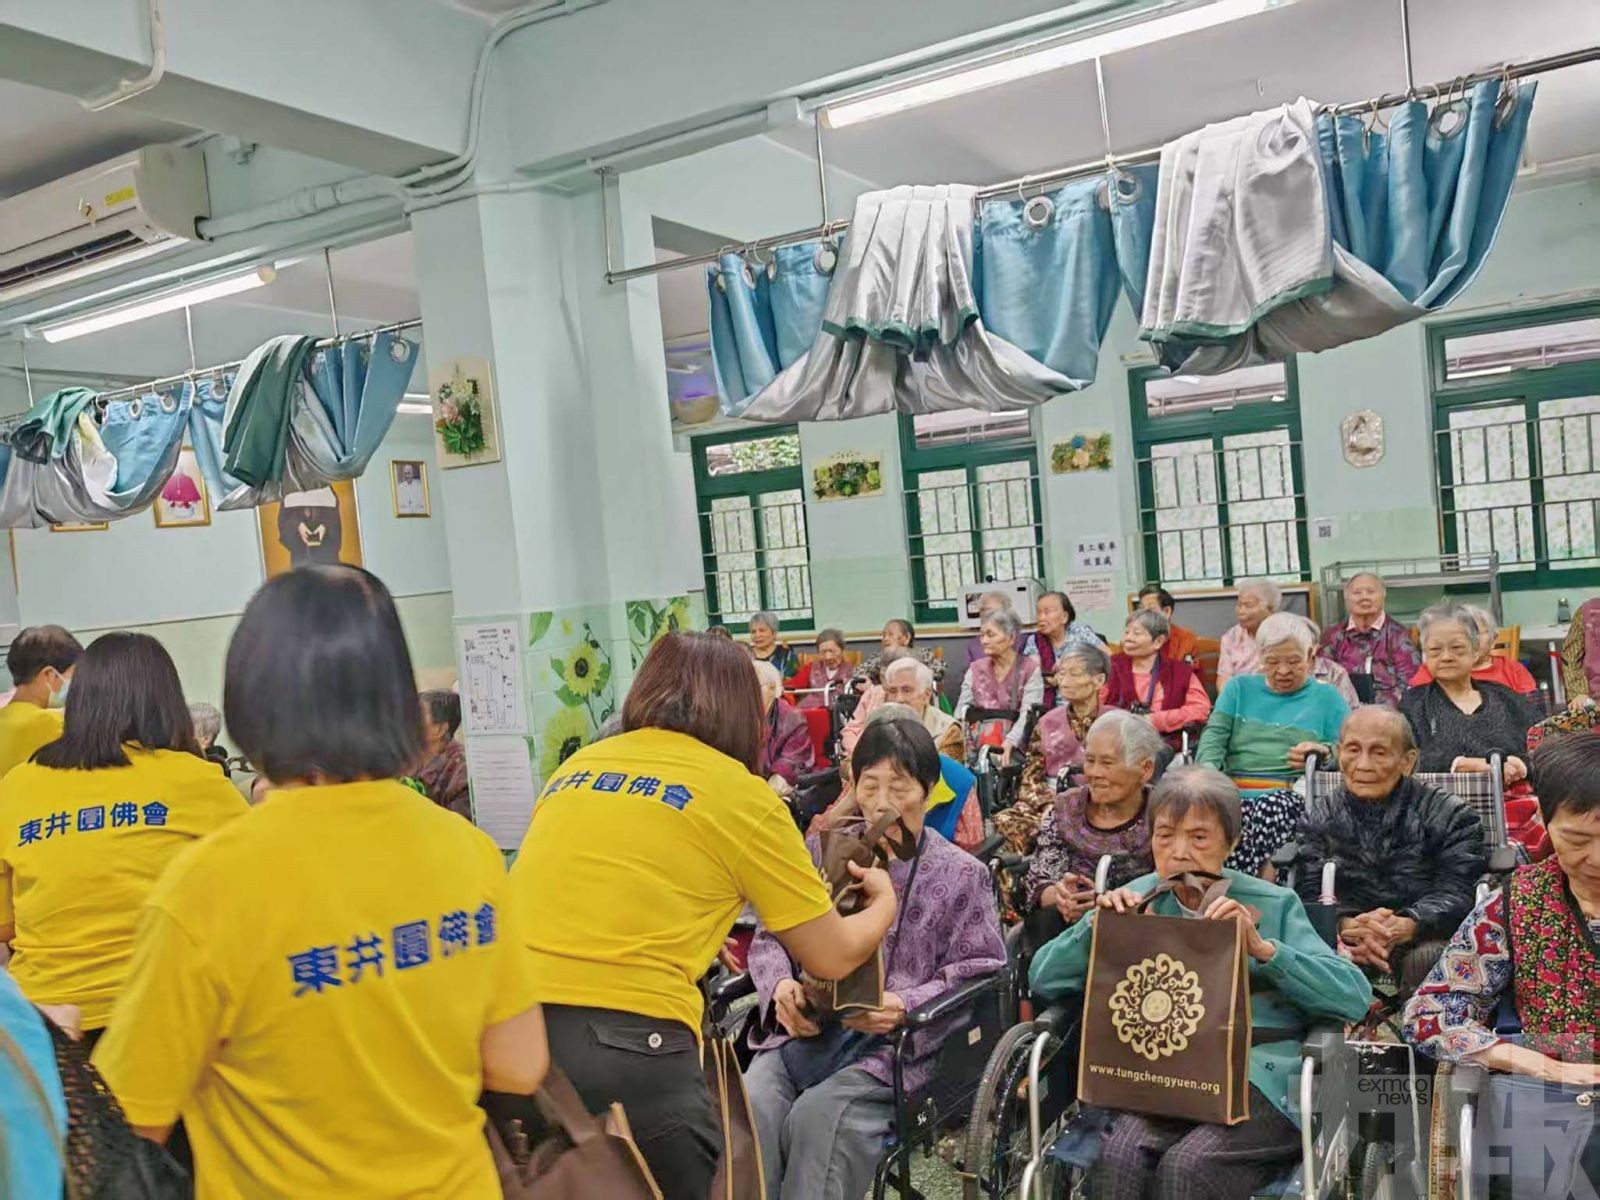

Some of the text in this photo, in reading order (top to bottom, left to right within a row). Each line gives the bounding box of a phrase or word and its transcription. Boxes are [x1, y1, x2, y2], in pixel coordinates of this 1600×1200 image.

[18, 801, 169, 847] 東井圓佛會
[1089, 1063, 1221, 1096] www.tungchengyuen.org
